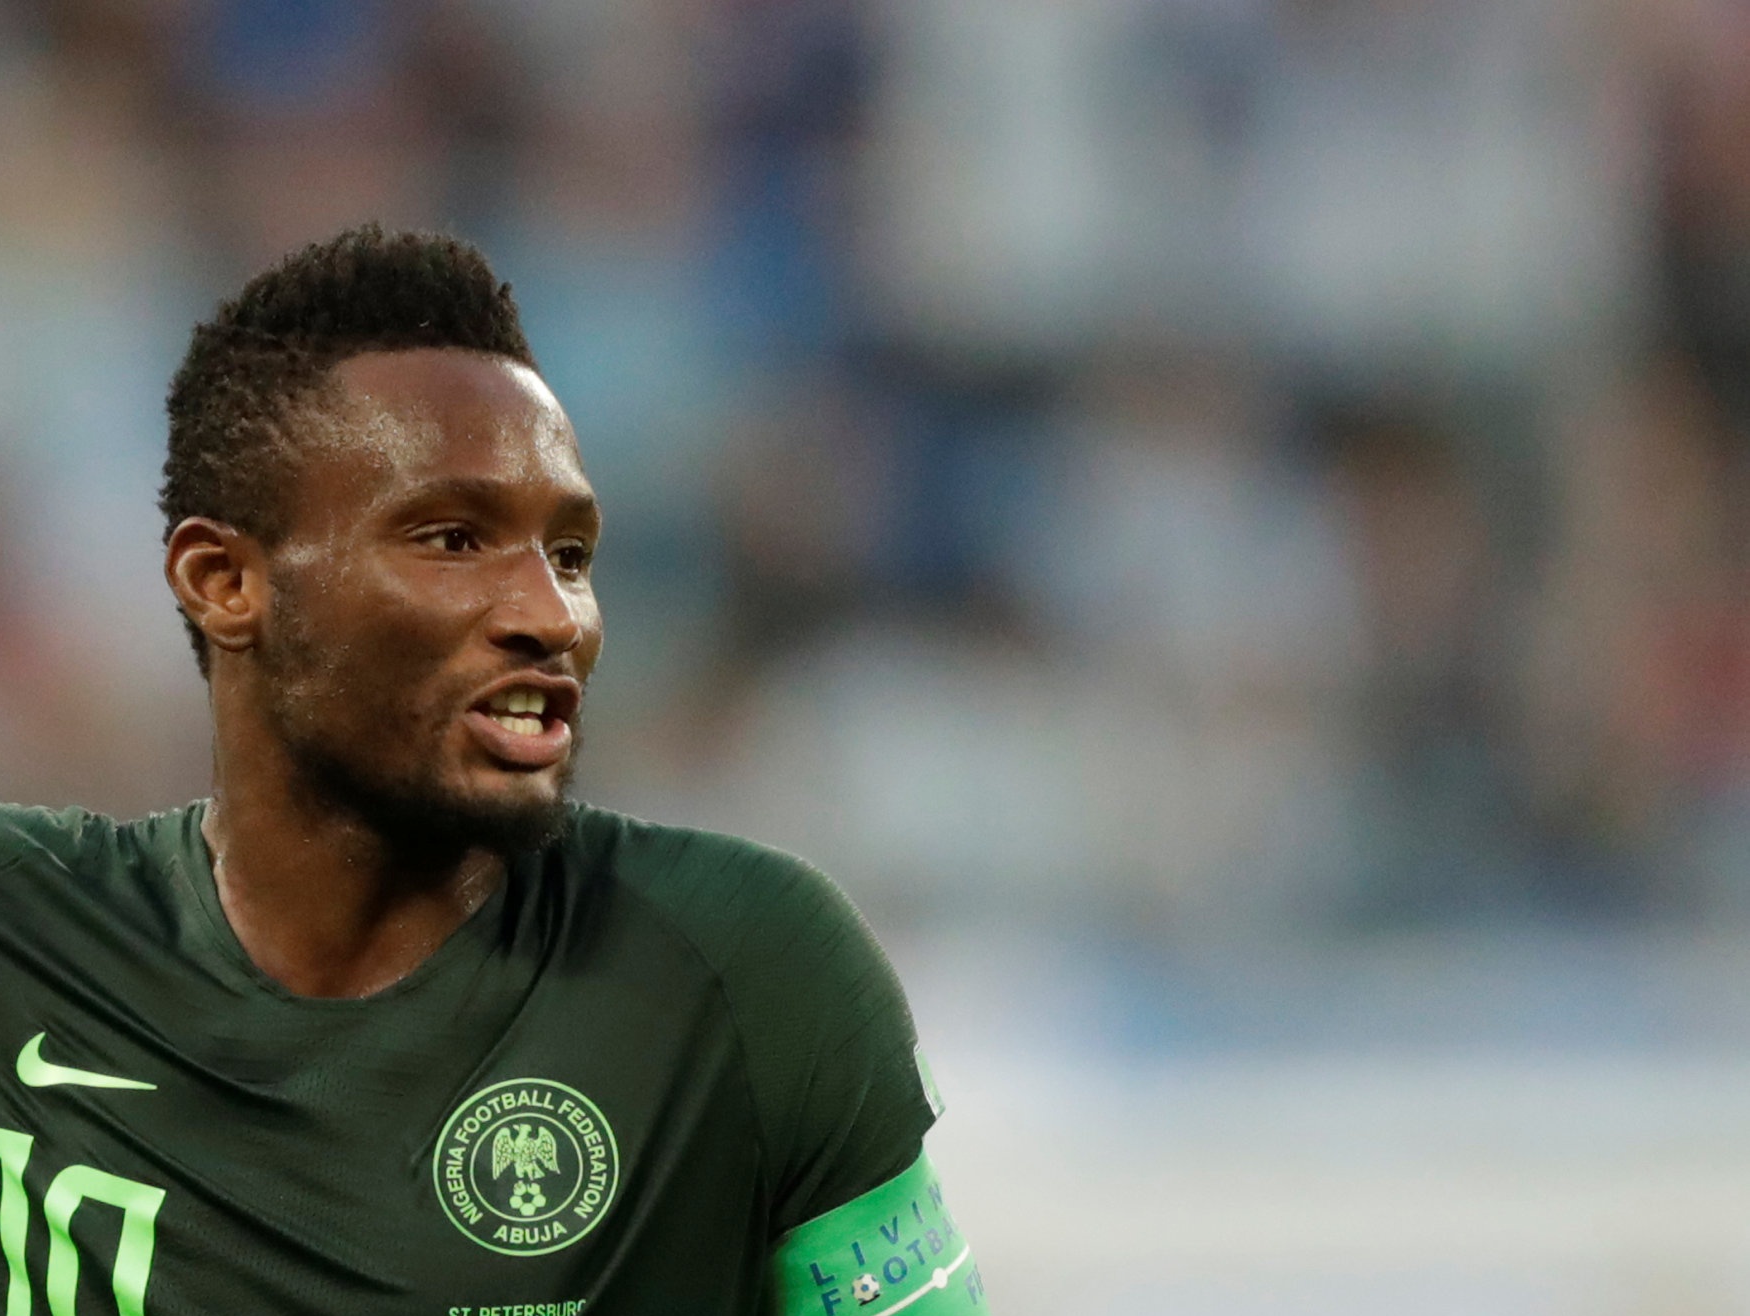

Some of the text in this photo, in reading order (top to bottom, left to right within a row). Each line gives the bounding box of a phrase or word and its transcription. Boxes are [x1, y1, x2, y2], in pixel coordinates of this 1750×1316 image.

[446, 1089, 608, 1226] NIGERIA FOOTBALL FEDERATION
[493, 1220, 568, 1245] ABUJA
